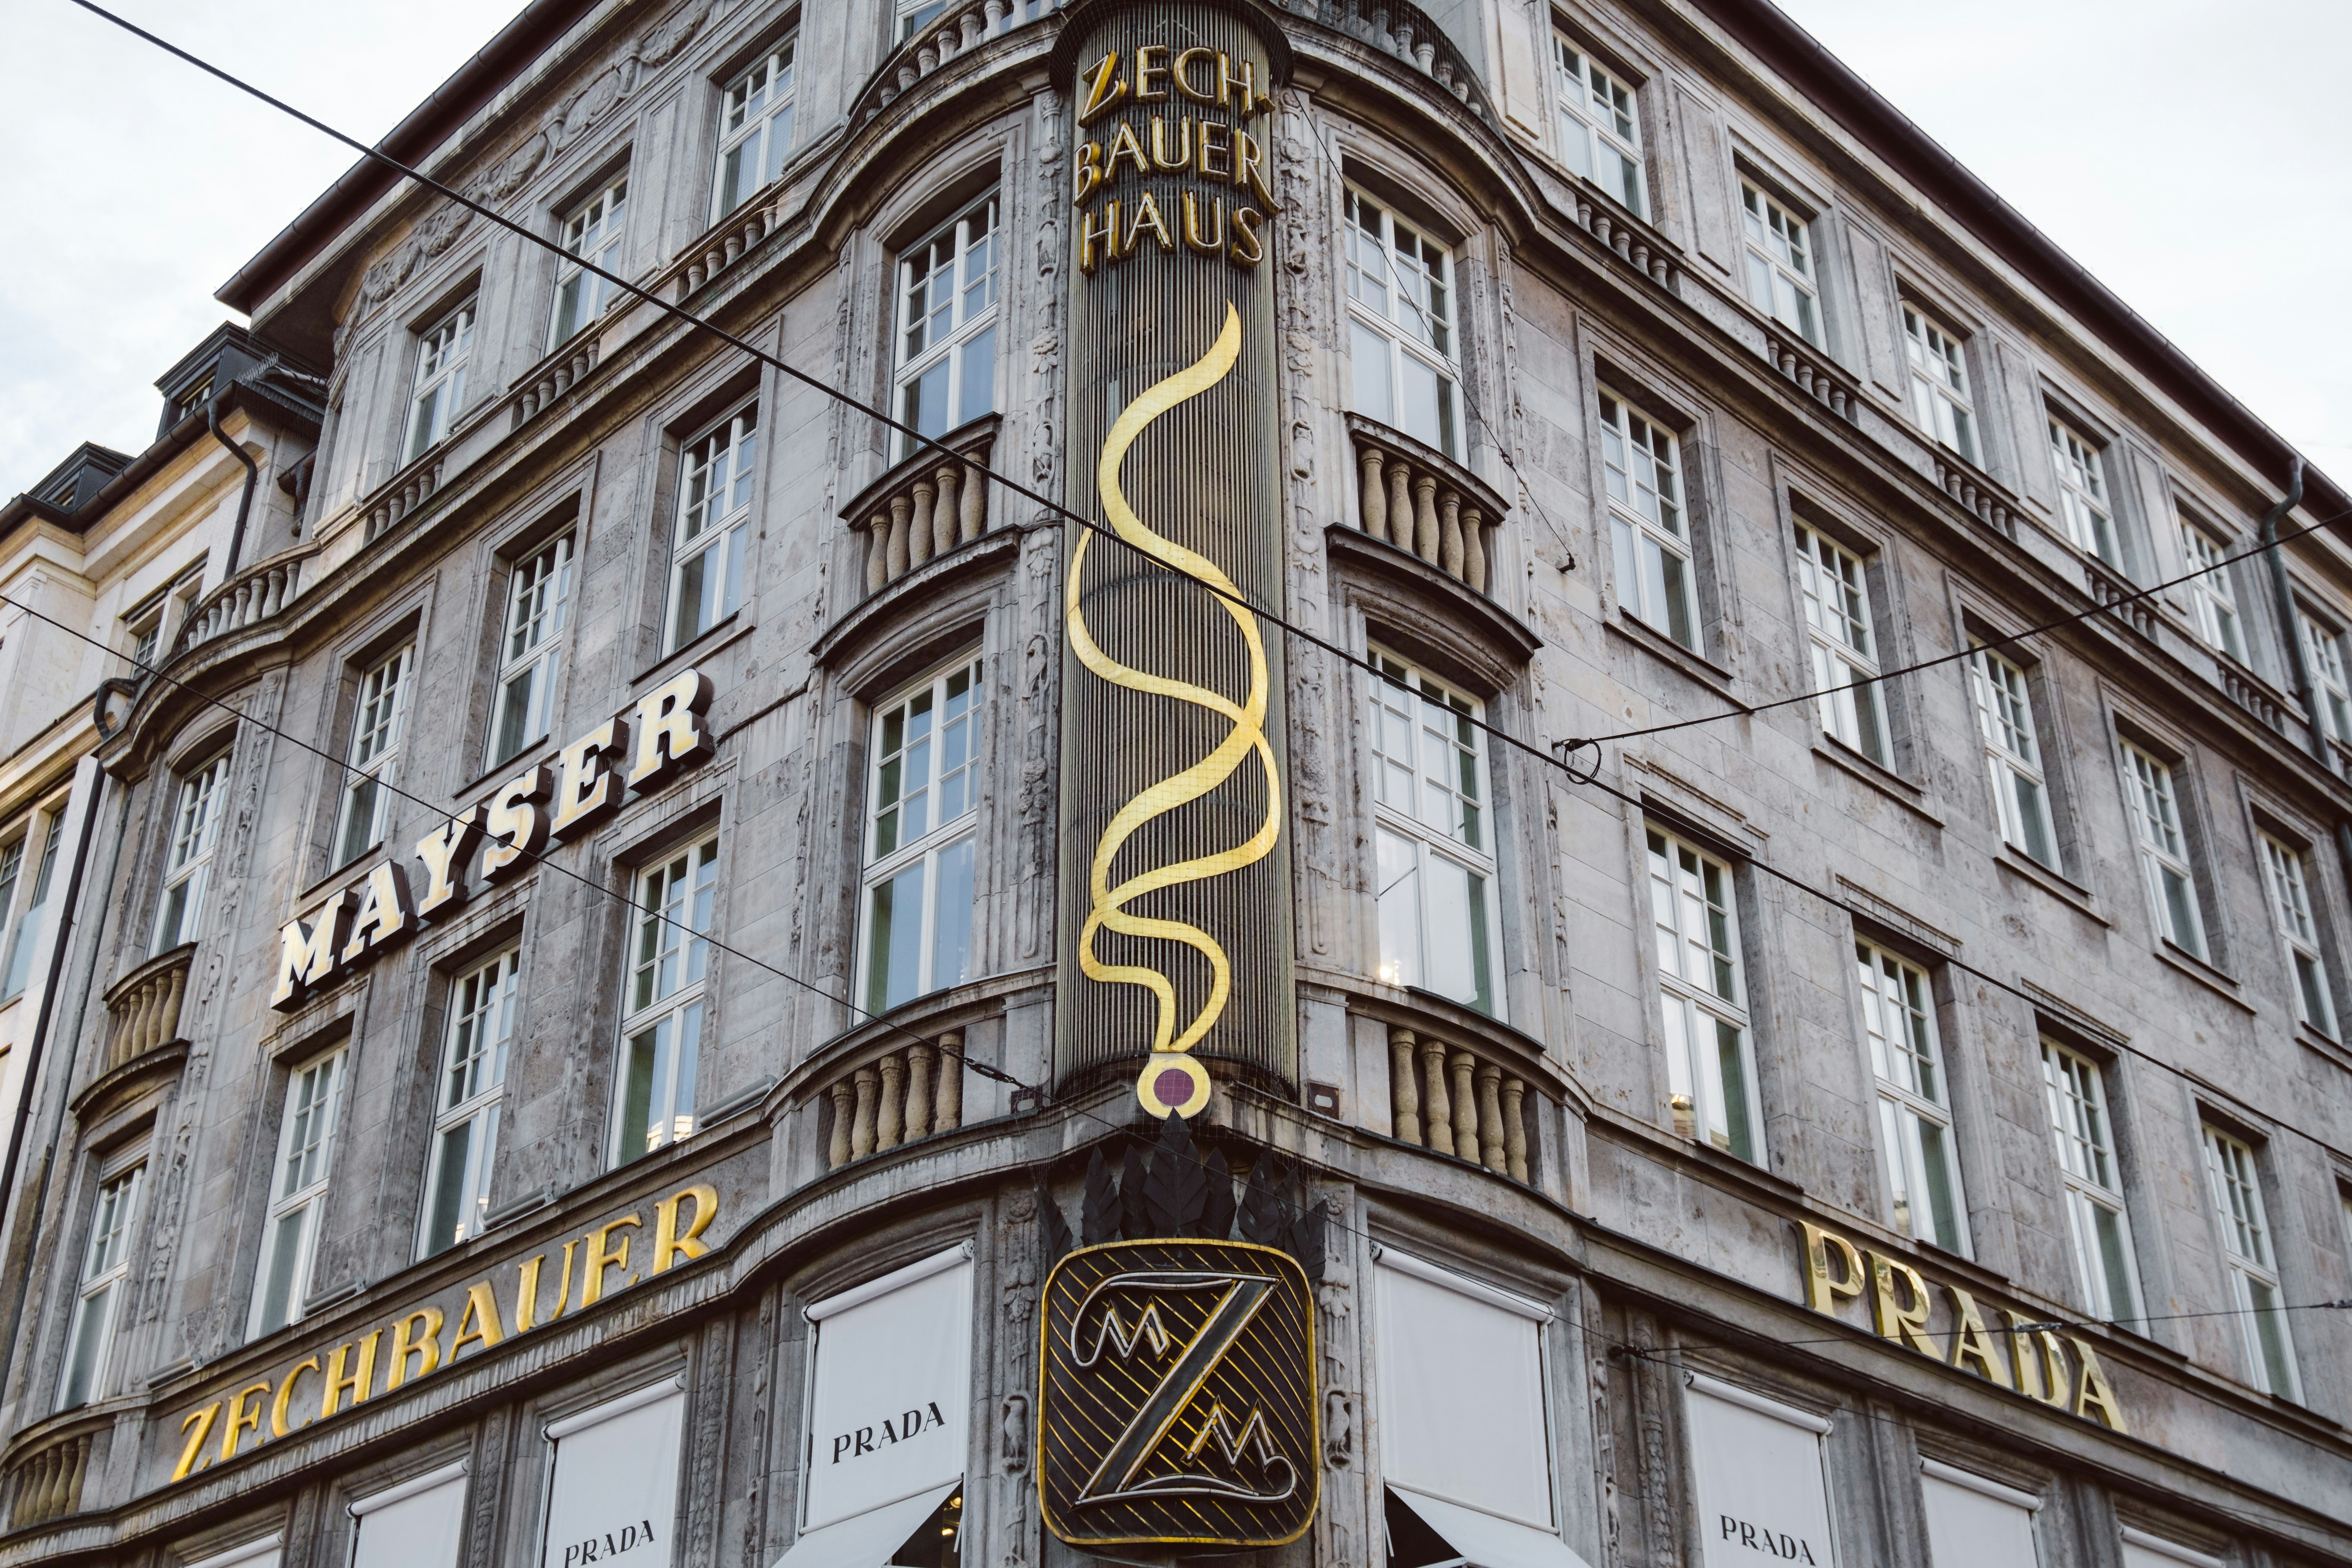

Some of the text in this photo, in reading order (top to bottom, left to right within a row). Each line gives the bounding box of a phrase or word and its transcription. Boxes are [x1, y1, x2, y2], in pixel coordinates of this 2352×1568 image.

[1073, 115, 1282, 215] BAUER
[1080, 189, 1264, 276] HAUS
[269, 668, 714, 1013] MAYSER
[170, 1183, 718, 1482] ZECHBAUER
[1795, 1220, 2127, 1435] PRADA
[832, 1401, 946, 1465] PRADA
[565, 1519, 655, 1568] PRADA
[1719, 1514, 1817, 1567] PRADA
